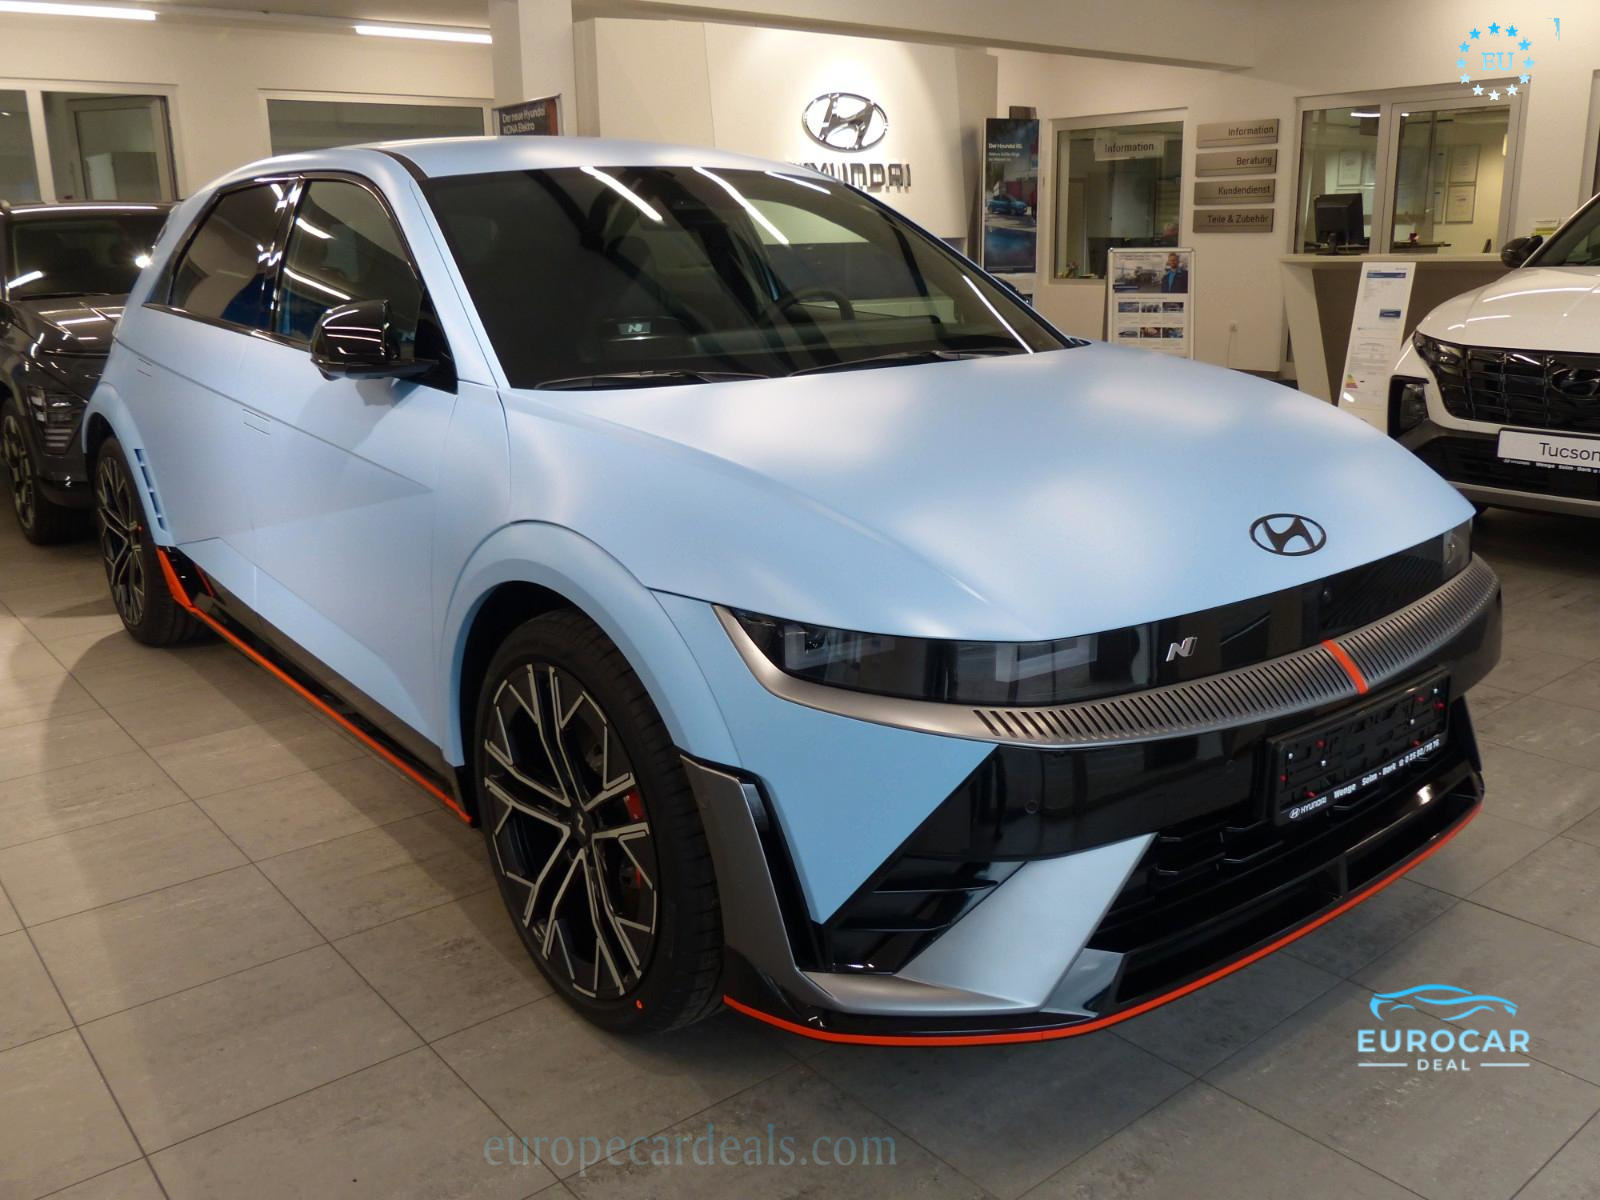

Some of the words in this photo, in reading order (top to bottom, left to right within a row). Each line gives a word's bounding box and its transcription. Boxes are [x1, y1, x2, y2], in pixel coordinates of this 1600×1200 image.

[1228, 125, 1274, 137] Information
[1105, 142, 1154, 153] Information
[1236, 156, 1272, 167] Beratung
[803, 162, 911, 190] UNDAI
[1218, 185, 1270, 196] Kundendienst
[1207, 214, 1226, 224] Teile
[1227, 214, 1234, 224] &
[1235, 213, 1269, 224] Zubehör
[1539, 442, 1600, 462] Tucson
[1300, 796, 1328, 814] HYUNDAI
